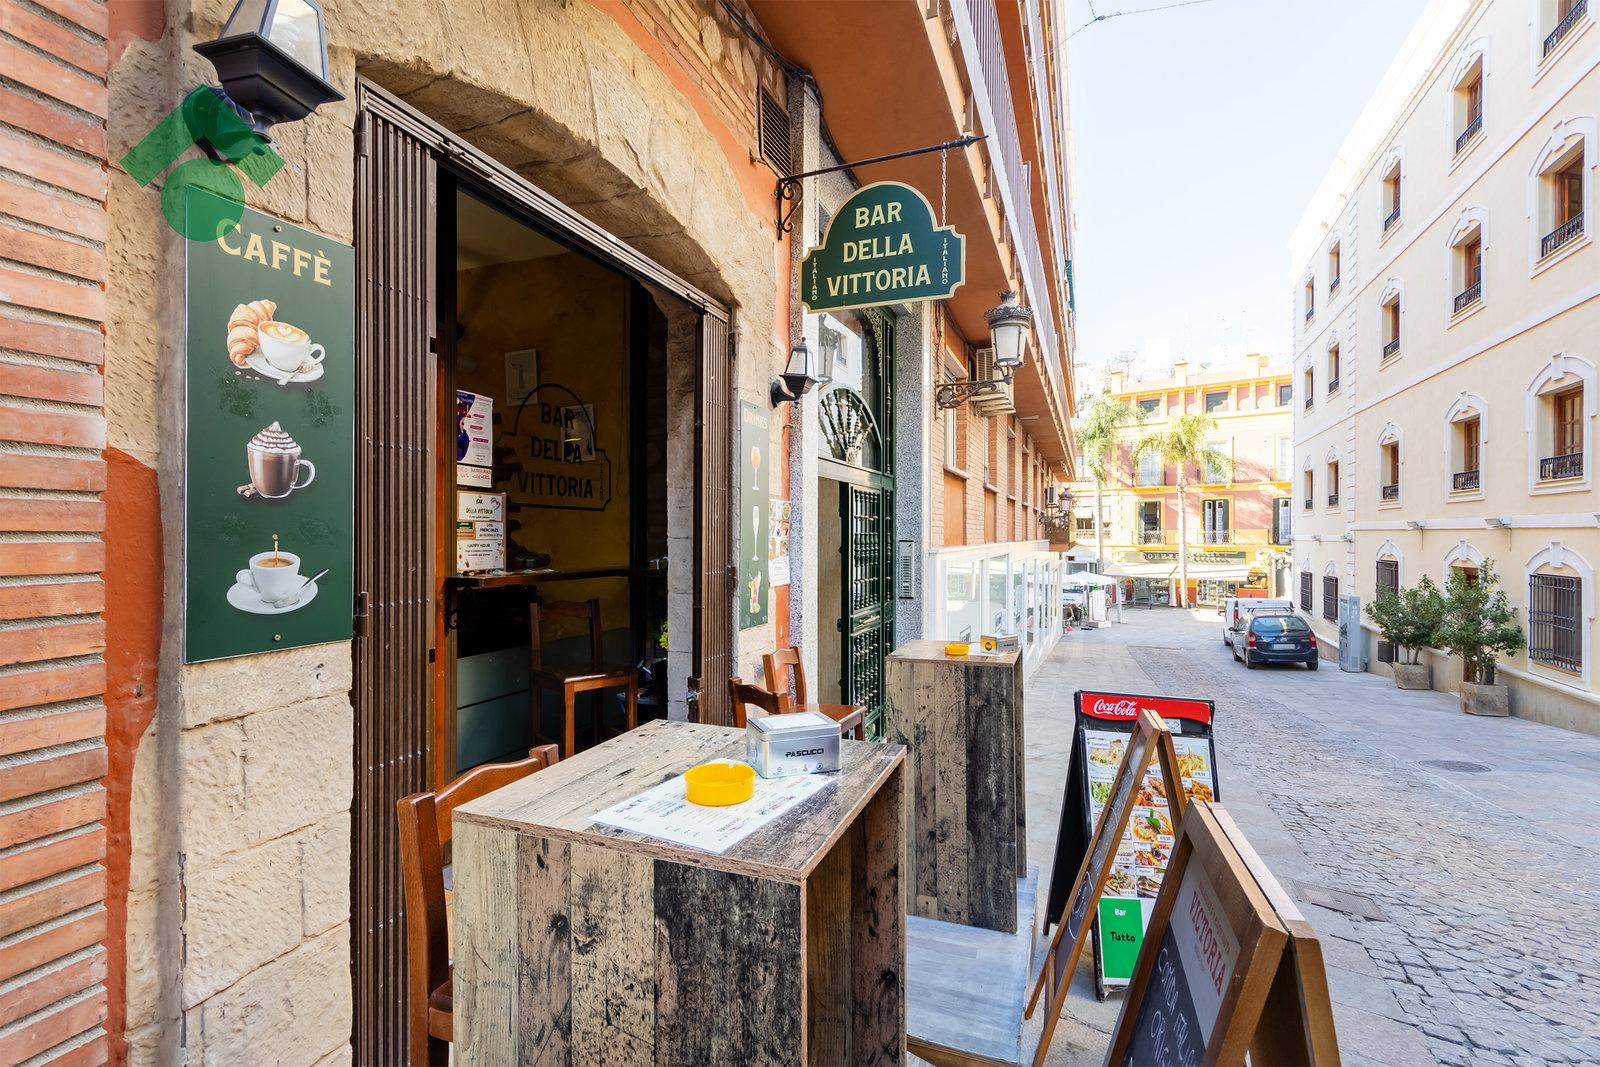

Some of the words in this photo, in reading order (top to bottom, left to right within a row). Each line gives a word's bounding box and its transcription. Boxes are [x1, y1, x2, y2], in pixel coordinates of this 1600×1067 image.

[854, 201, 903, 229] BAR
[216, 217, 332, 287] CAFFÈ
[843, 232, 914, 263] DELLA
[941, 237, 949, 285] ITALIANO
[826, 264, 932, 297] VITTORIA
[541, 402, 575, 430] BAR
[743, 406, 767, 430] DRINKS
[530, 435, 583, 465] DELLA
[518, 472, 594, 499] VITTORIA
[1094, 698, 1138, 716] Coca-Cola
[785, 748, 824, 758] PASCUCCI
[1114, 908, 1127, 916] Bar
[1110, 931, 1136, 942] Tutto
[1189, 890, 1226, 996] VICTORIA
[1158, 948, 1179, 1016] COMIDA
[1173, 1012, 1196, 1067] ITALIA
[1150, 1010, 1173, 1067] ORIG
